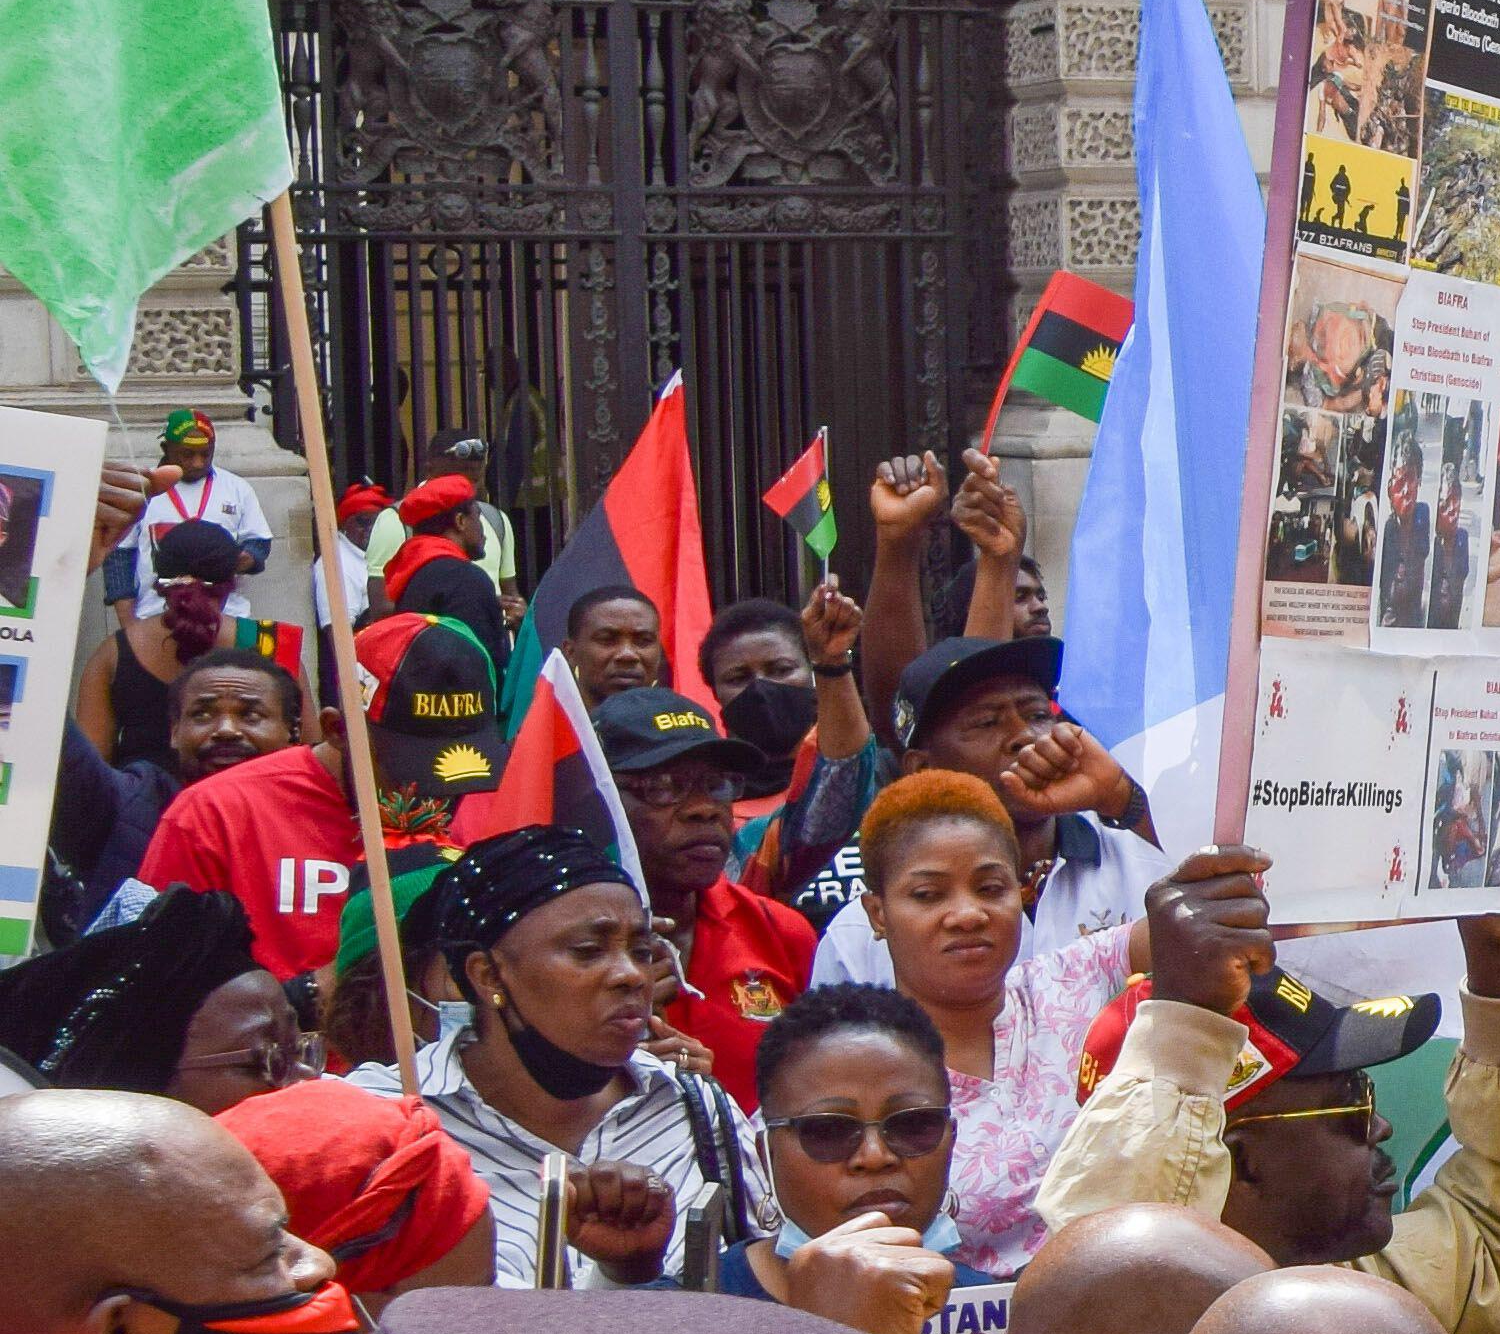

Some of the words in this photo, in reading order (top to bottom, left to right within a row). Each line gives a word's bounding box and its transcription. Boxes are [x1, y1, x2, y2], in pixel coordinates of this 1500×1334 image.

[1461, 2, 1500, 29] Bloodbath
[1446, 23, 1481, 48] Christians
[1319, 233, 1373, 255] BIAFRANS
[1437, 291, 1469, 311] BIAFRA
[1411, 317, 1426, 333] Stop
[1426, 320, 1460, 340] President
[1460, 326, 1482, 341] Buhari
[1482, 330, 1490, 342] of
[1402, 341, 1426, 359] Nigeria
[1426, 345, 1461, 364] Bloodbath
[1461, 351, 1470, 364] to
[1409, 368, 1445, 385] Christians
[1445, 373, 1483, 393] (Genocide)
[413, 691, 484, 718] BIAFRA
[1252, 778, 1403, 813] #StopBiafraKillings
